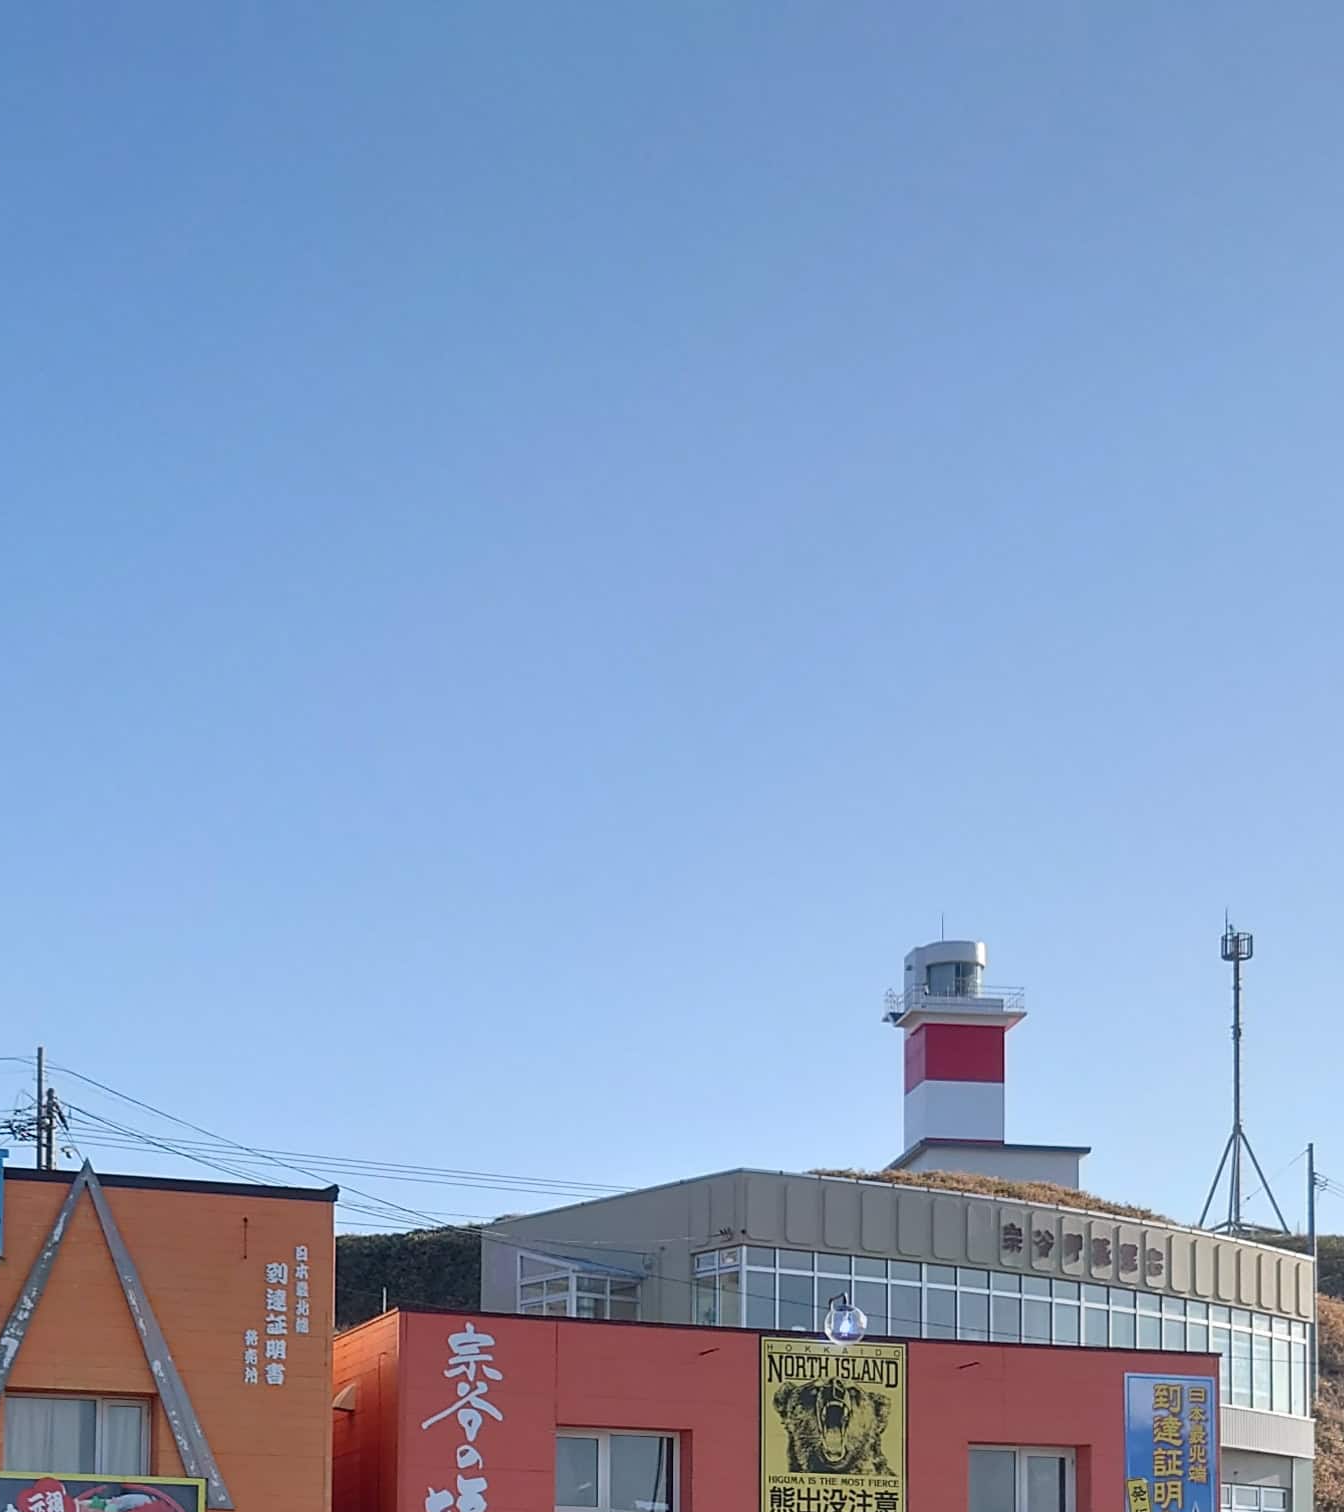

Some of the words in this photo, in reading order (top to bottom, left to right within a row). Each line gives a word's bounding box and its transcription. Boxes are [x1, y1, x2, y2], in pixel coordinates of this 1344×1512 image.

[265, 1262, 288, 1385] 到達証明書
[767, 1344, 901, 1358] HOKKAIDO
[768, 1354, 830, 1383] NORTH
[835, 1357, 899, 1388] ISLAND
[1187, 1387, 1208, 1483] 日本最北端
[768, 1475, 805, 1485] HIGUMA
[808, 1477, 817, 1485] IS
[820, 1477, 837, 1486] THE
[841, 1478, 865, 1486] MOST
[868, 1479, 899, 1488] FIERCE
